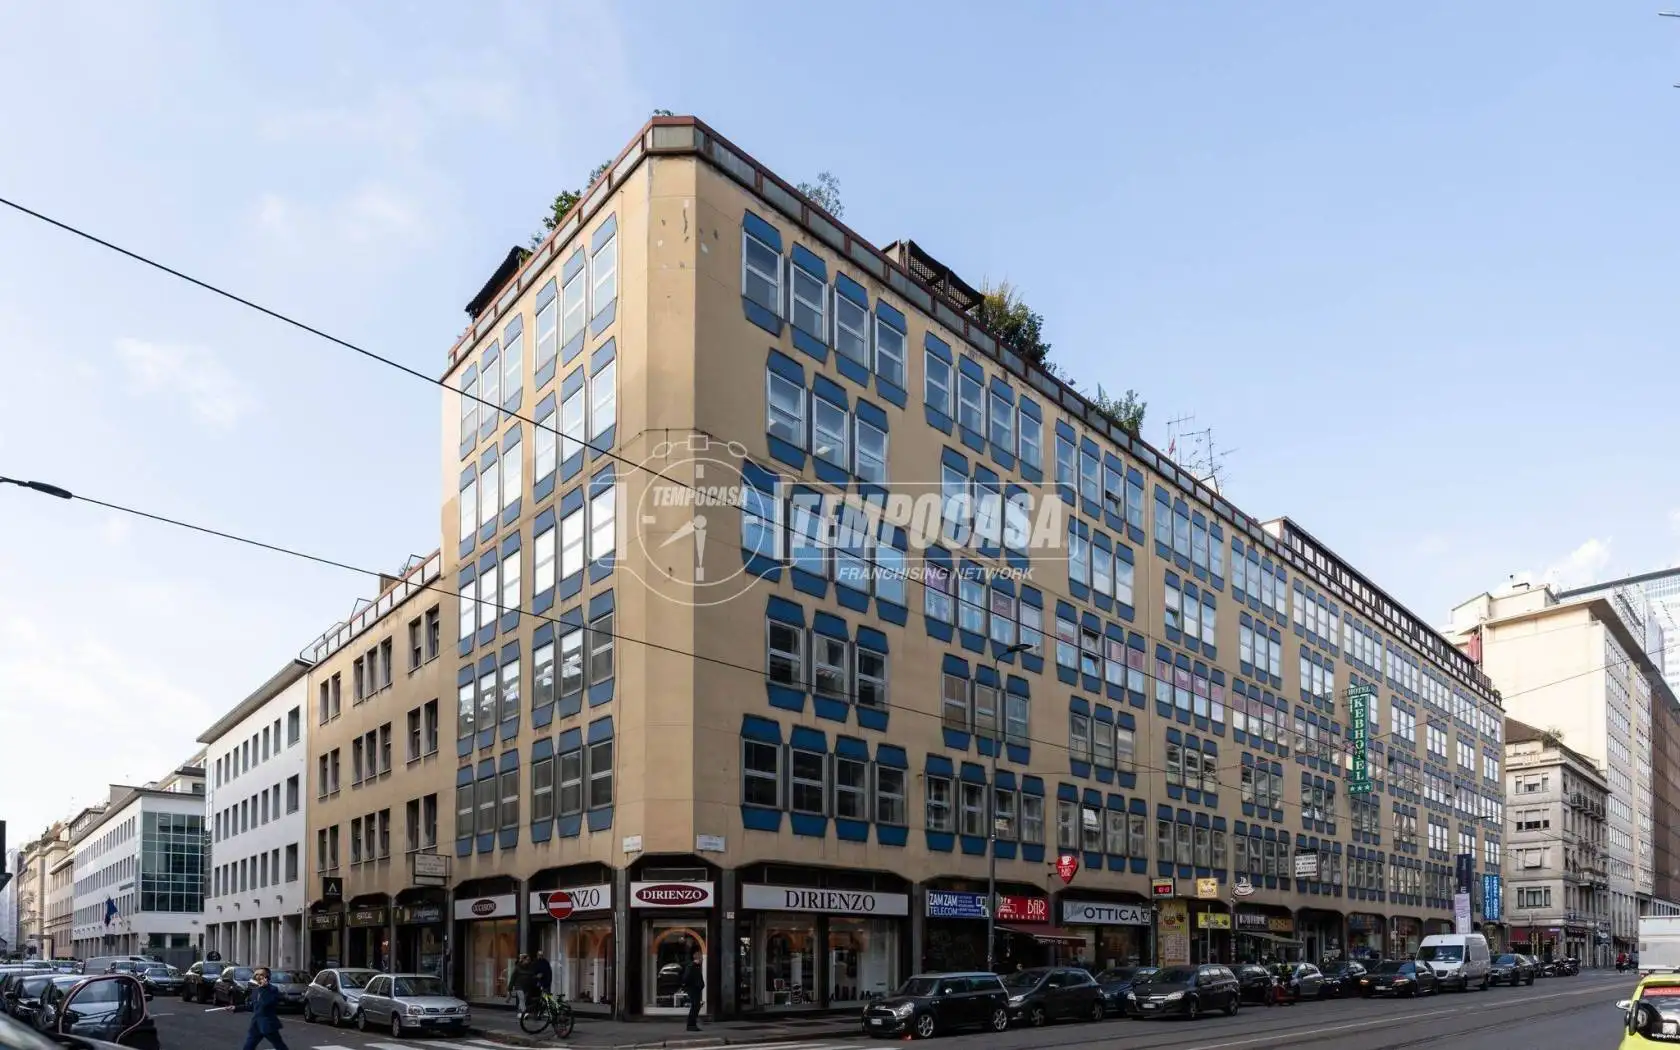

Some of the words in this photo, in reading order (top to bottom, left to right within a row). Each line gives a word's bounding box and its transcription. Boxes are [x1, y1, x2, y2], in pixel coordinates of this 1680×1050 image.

[1348, 686, 1370, 695] HOTEL
[642, 890, 702, 900] DIRIENZO
[785, 890, 876, 912] DIRIENZO
[929, 893, 943, 906] ZAM
[944, 894, 958, 907] ZAM
[929, 906, 958, 916] TELECOM
[1027, 899, 1045, 915] BAR
[1084, 907, 1139, 921] OTTICA
